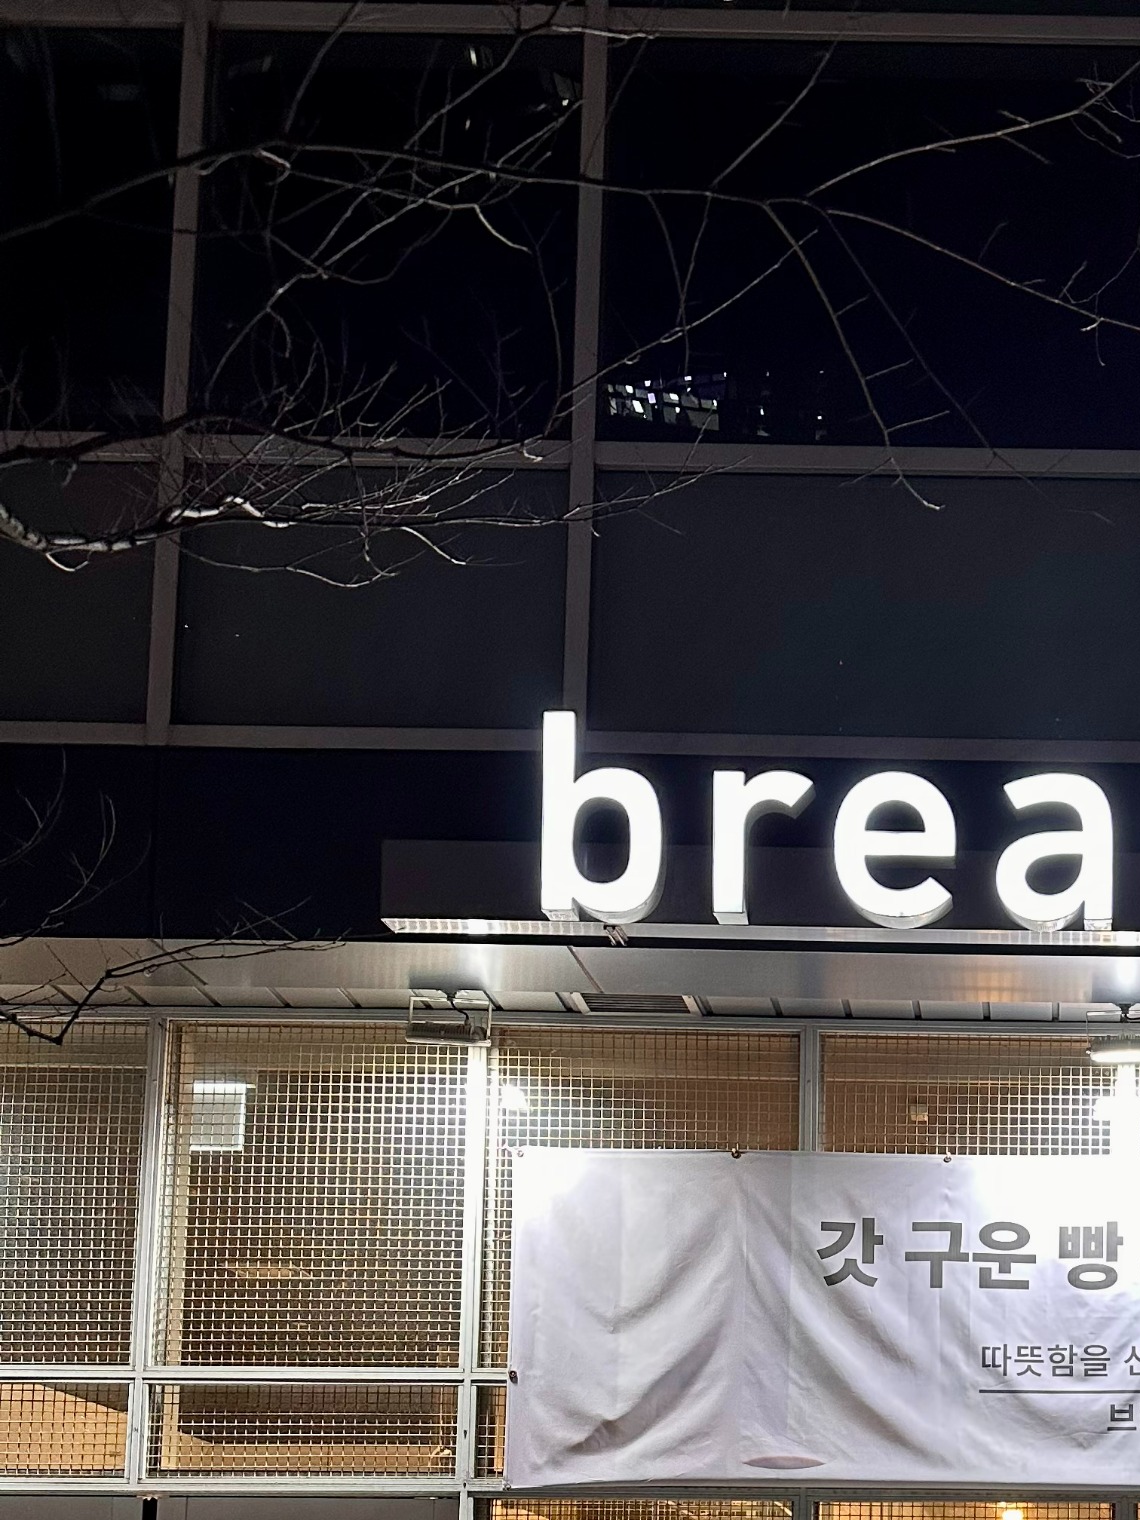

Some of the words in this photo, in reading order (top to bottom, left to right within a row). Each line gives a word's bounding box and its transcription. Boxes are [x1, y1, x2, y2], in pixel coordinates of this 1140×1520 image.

[816, 1217, 884, 1288] 갓
[903, 1220, 1037, 1290] 구운
[980, 1343, 1111, 1378] 따뜻함을
